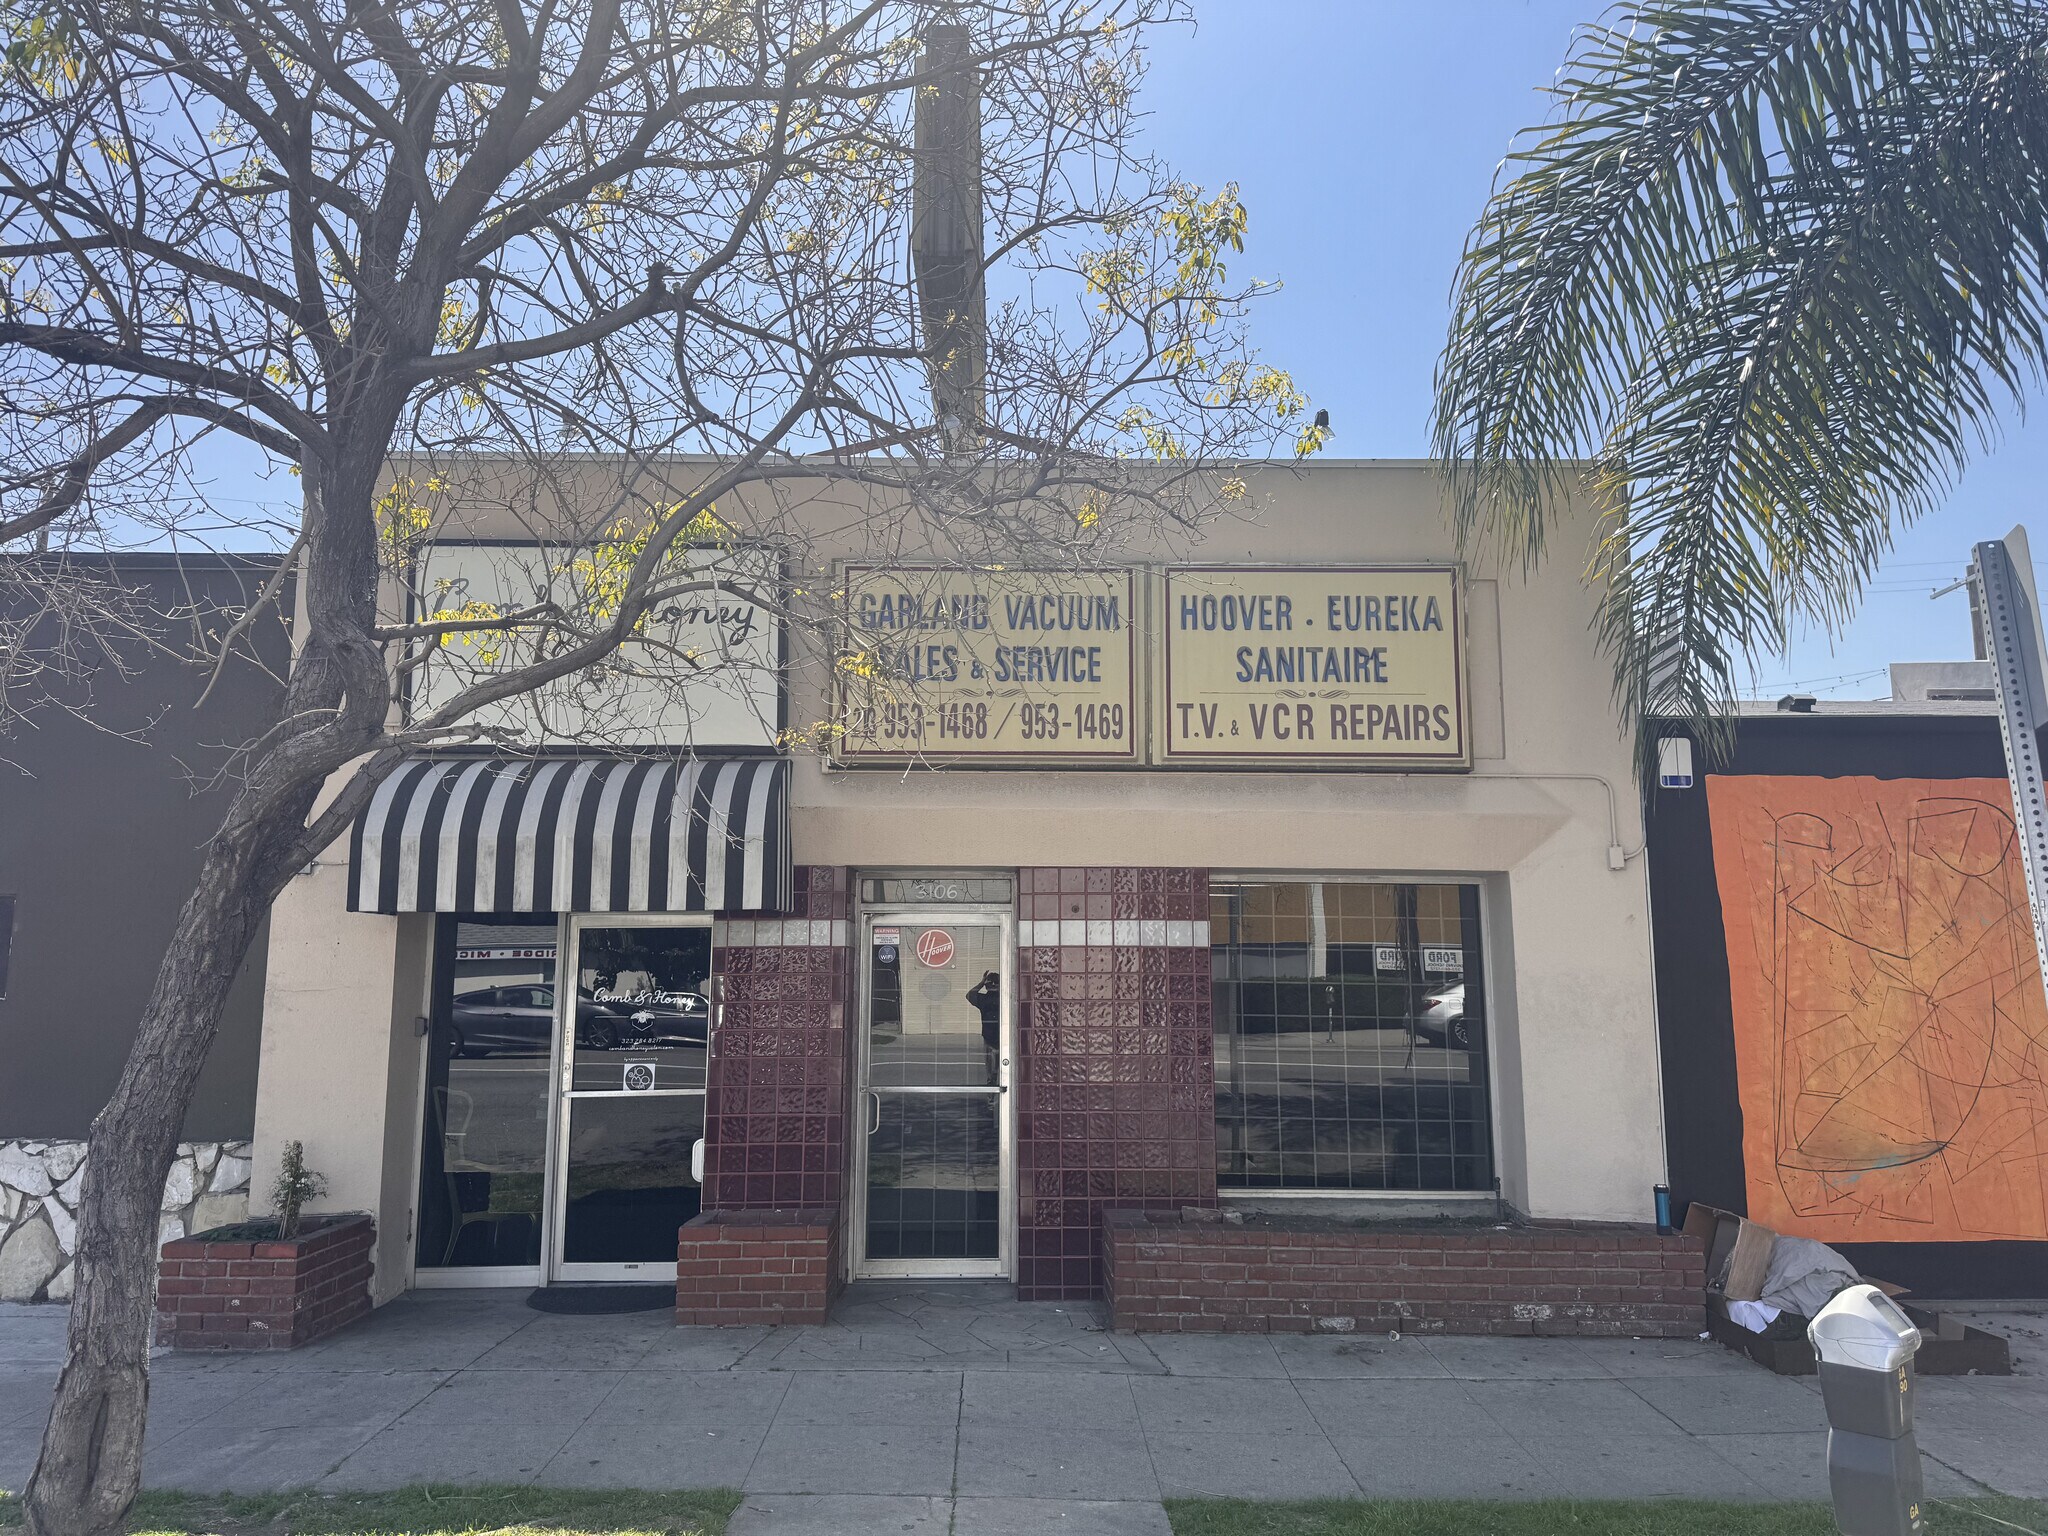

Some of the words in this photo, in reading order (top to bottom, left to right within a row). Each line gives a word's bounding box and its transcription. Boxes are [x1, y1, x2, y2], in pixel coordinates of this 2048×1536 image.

[860, 593, 989, 630] GARLAND
[1004, 595, 1120, 631] VACUUM
[1180, 594, 1293, 631] HOOVER
[1327, 595, 1444, 632] EUREKA
[970, 660, 985, 680] &
[995, 646, 1102, 683] SERVICE
[1236, 646, 1388, 683] SANITAIRE
[884, 702, 988, 739] 953-1468
[1021, 703, 1124, 740] 953-1469
[1176, 703, 1224, 739] T.V.
[1230, 719, 1240, 736] &
[1249, 703, 1315, 740] VCR
[1330, 704, 1451, 741] REPAIRS
[915, 884, 958, 899] 3106
[593, 987, 632, 1003] Comb
[634, 990, 651, 1006] &
[651, 989, 696, 1011] Honey
[1909, 1502, 1920, 1520] GA
